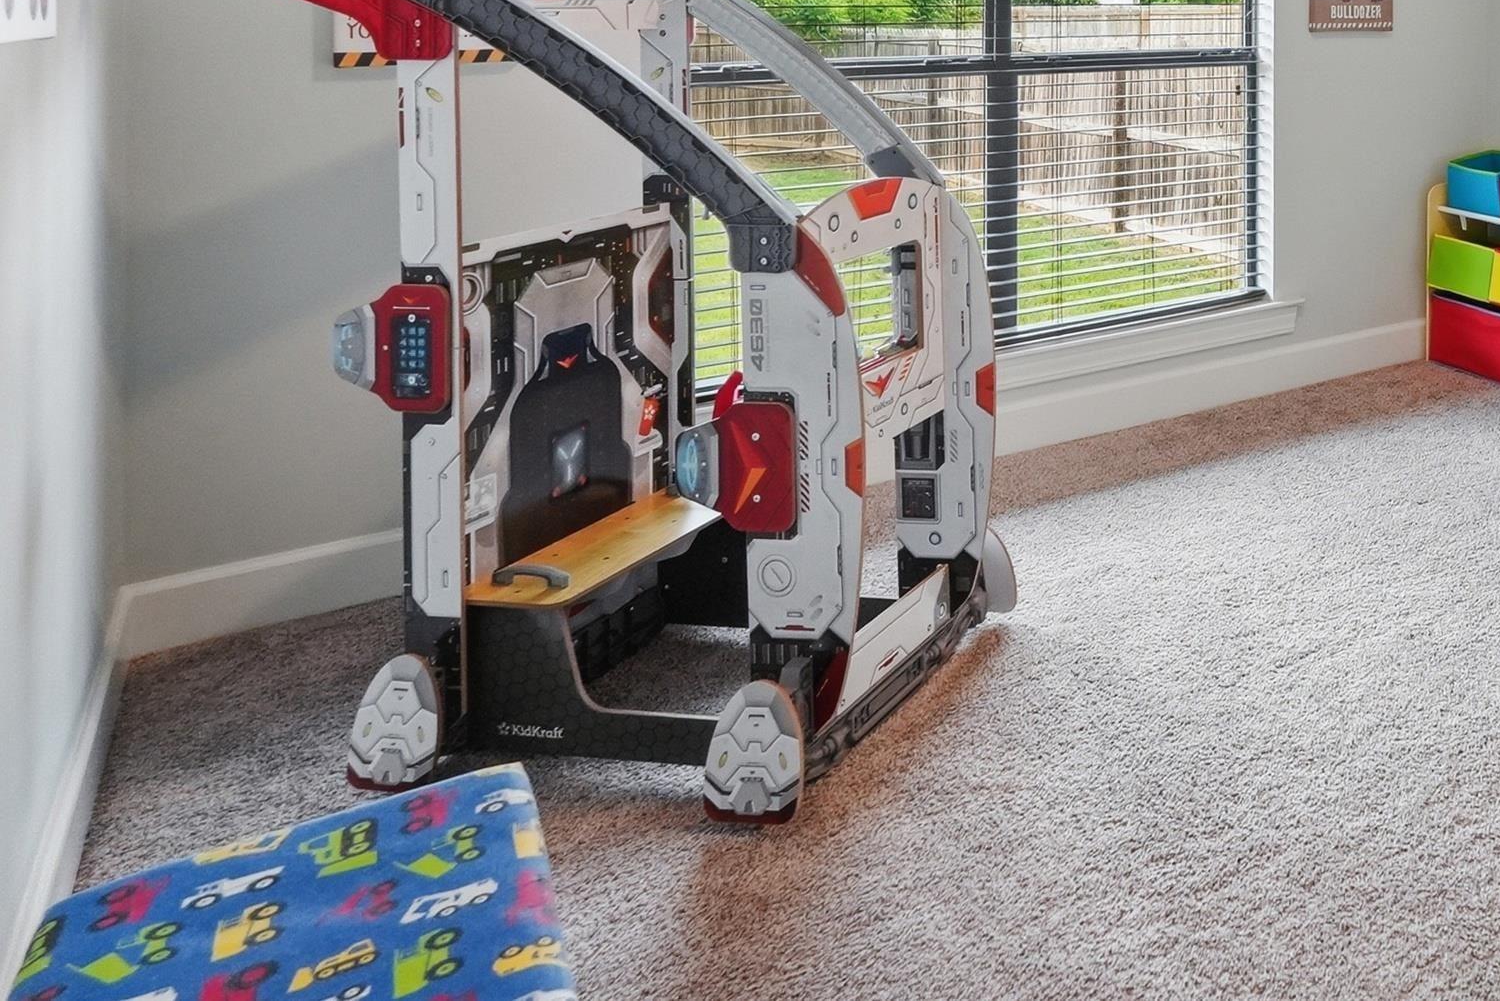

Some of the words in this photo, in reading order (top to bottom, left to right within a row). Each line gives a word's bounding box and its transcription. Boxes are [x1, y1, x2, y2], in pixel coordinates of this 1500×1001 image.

[1330, 4, 1382, 19] BULLDOZER
[749, 298, 765, 372] 4630
[511, 723, 565, 739] KidKraft
